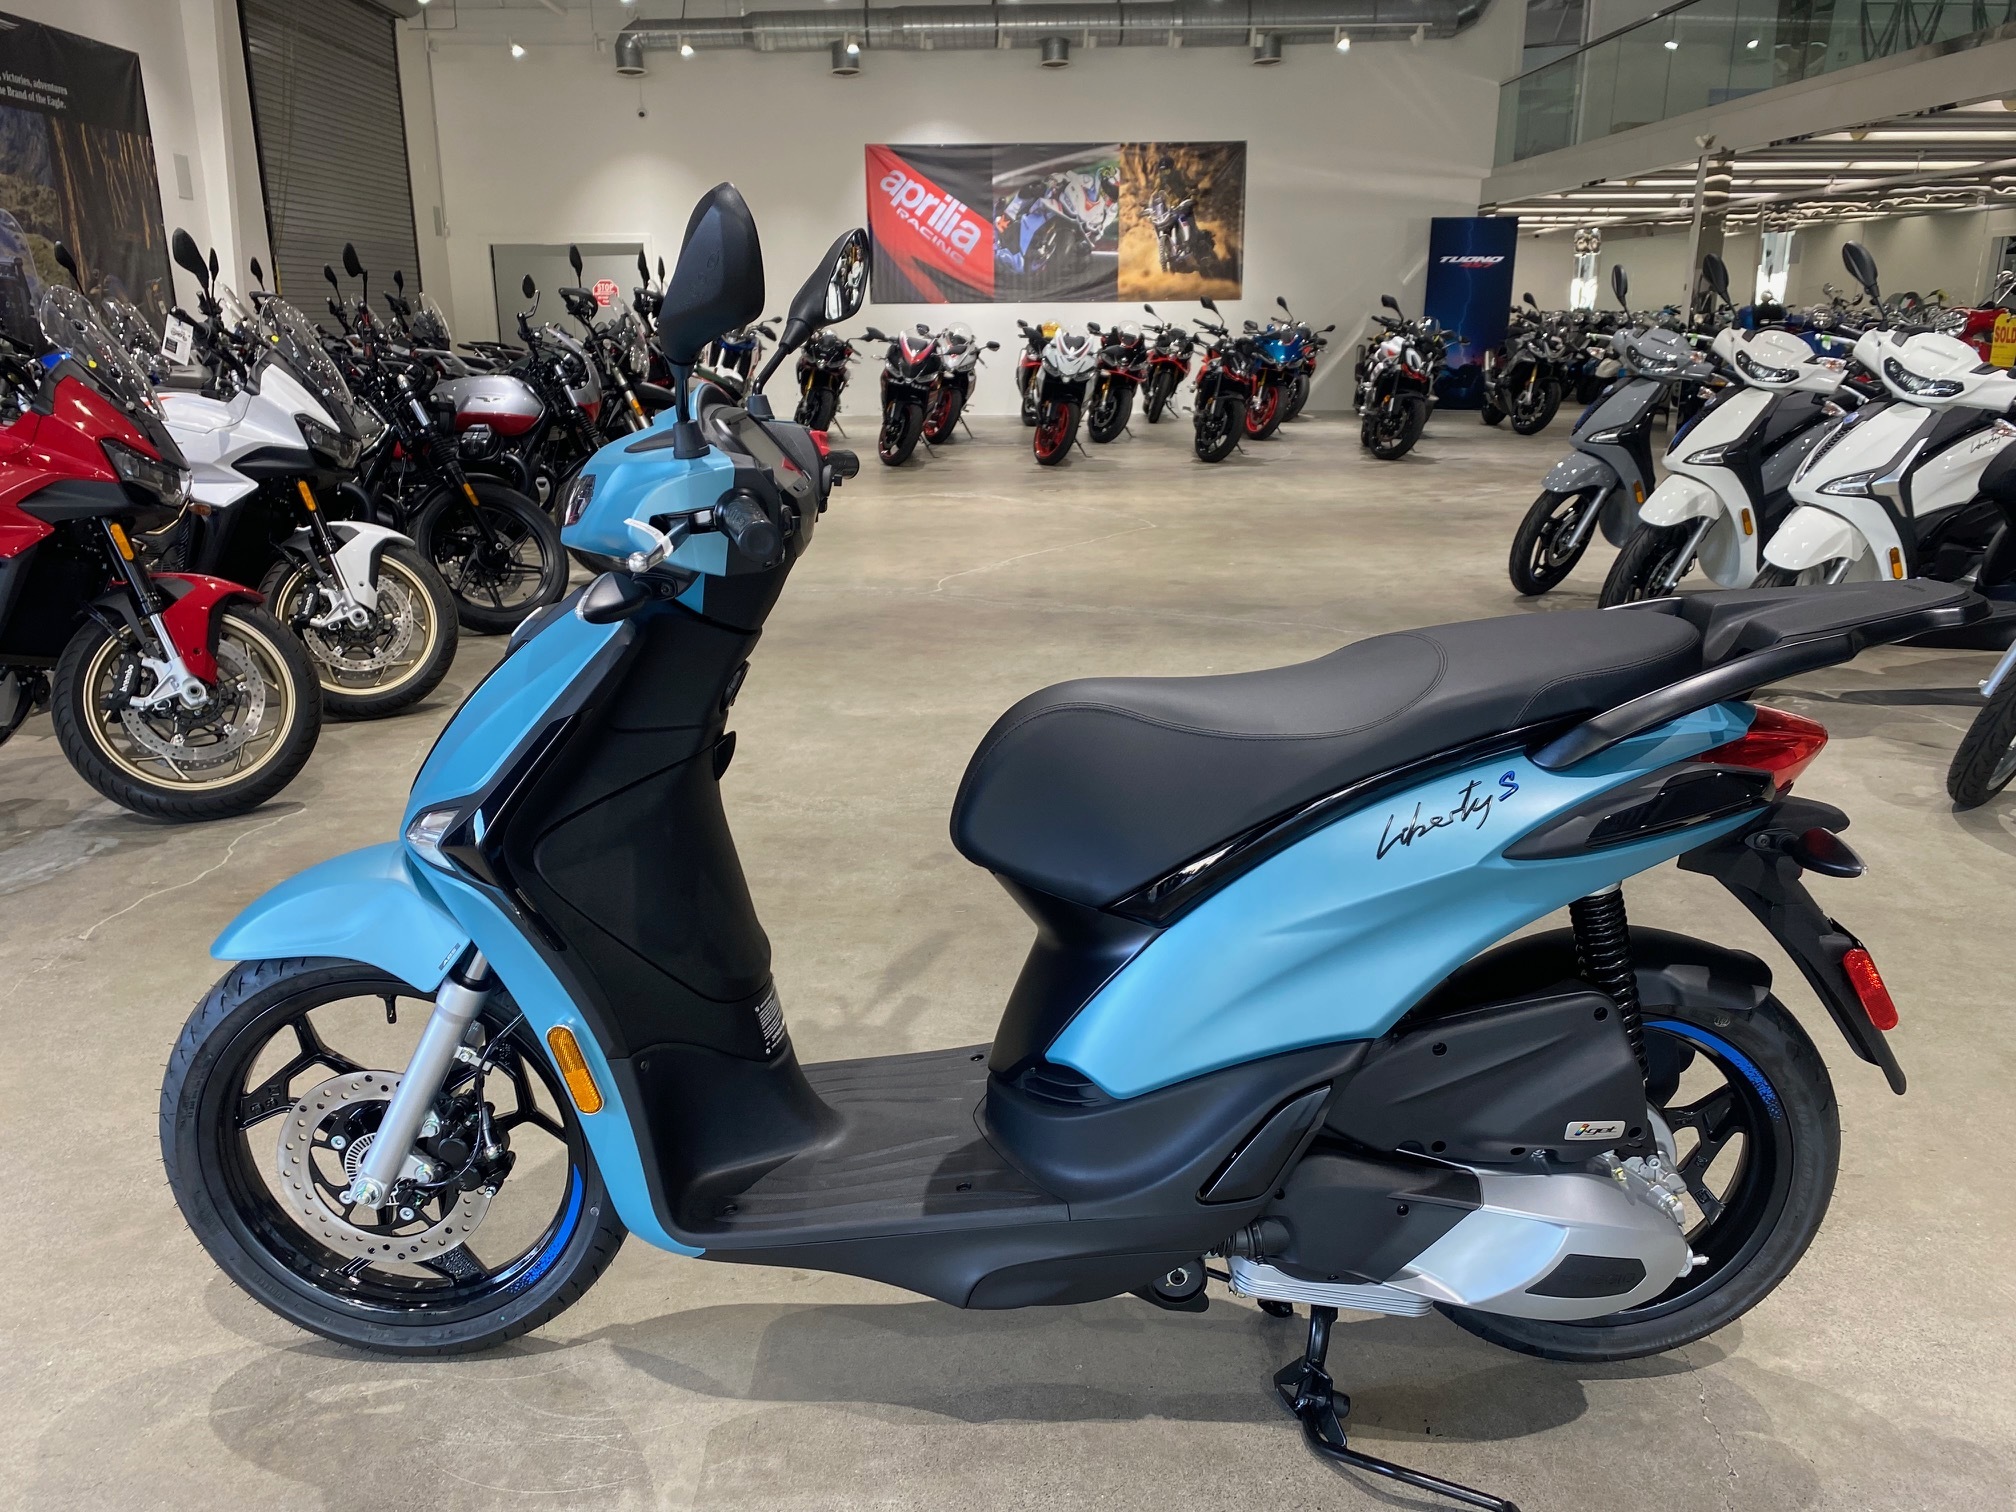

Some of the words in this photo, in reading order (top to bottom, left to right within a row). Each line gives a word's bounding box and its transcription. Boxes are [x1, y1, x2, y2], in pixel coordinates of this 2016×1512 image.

[7, 86, 28, 100] Brand
[28, 91, 35, 102] of
[35, 92, 47, 105] the
[47, 95, 67, 110] Eagle.
[33, 79, 68, 95] adventures
[880, 169, 982, 255] aprilia
[896, 207, 965, 265] RACING
[1439, 255, 1505, 263] TUONO
[597, 283, 614, 291] STOP
[1994, 325, 2016, 344] SOLD
[119, 664, 134, 692] brembo
[1376, 780, 1493, 860] Liberty
[1498, 770, 1520, 802] S
